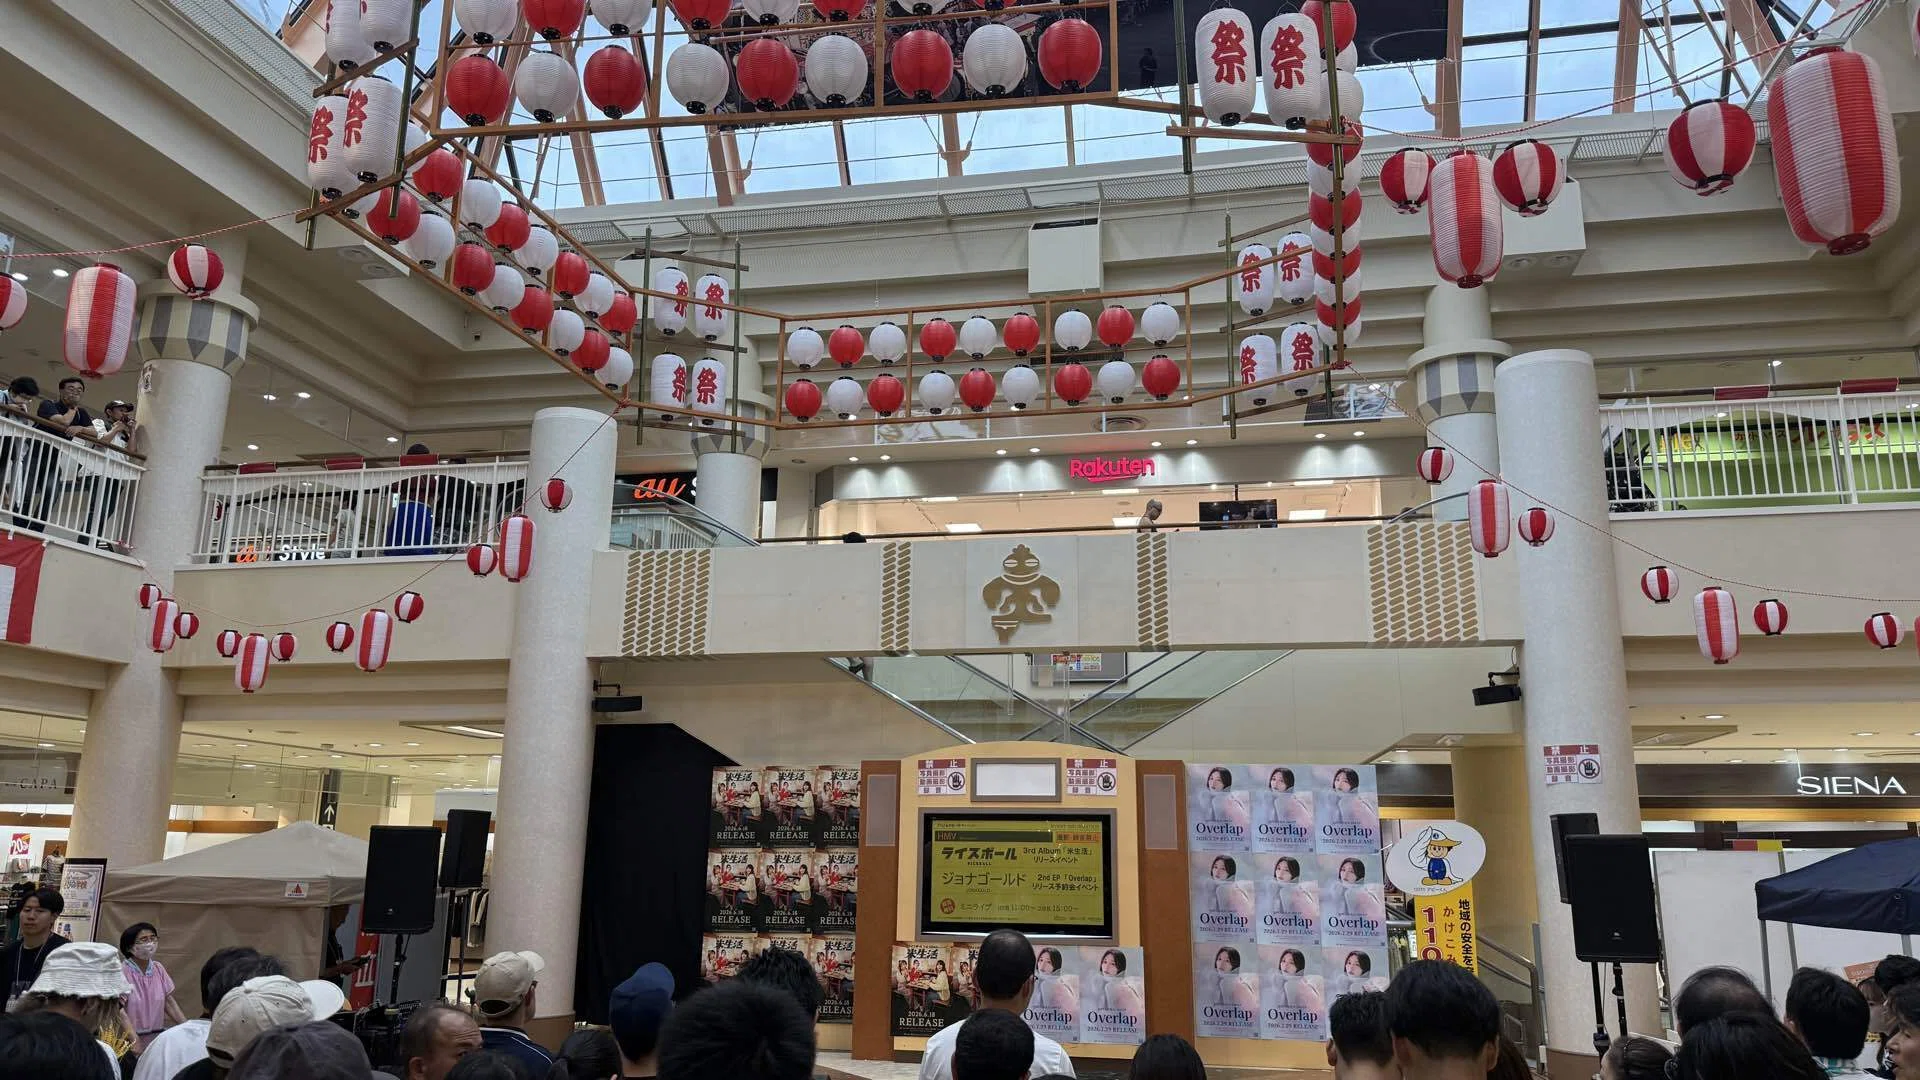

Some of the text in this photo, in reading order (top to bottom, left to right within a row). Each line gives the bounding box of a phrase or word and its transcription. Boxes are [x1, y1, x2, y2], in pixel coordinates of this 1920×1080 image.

[1211, 20, 1247, 85] 祭
[1270, 24, 1307, 89] 祭
[343, 88, 368, 148] 祭
[308, 105, 334, 164] 祭
[705, 282, 724, 320] 祭
[1292, 332, 1314, 370] 祭
[1241, 345, 1257, 384] 祭
[672, 363, 687, 403] 祭
[697, 367, 717, 404] 祭
[1070, 457, 1155, 478] Rakuten
[634, 478, 687, 499] au
[279, 543, 326, 561] Style
[1797, 776, 1907, 795] SIENA
[937, 832, 957, 840] HMV
[1196, 823, 1244, 836] Overlap
[1258, 824, 1307, 837] Overlap
[1322, 825, 1372, 838] Overlap
[942, 846, 1017, 860] ライスボール
[942, 871, 1027, 886] ジョナゴールド
[960, 903, 993, 911] ミニライブ
[711, 916, 751, 924] RELEASE
[765, 916, 805, 924] RELEASE
[820, 917, 857, 925] RELEAS
[1200, 913, 1248, 927] Overlap
[1264, 915, 1313, 929] Overlap
[1328, 917, 1378, 930] Overlap
[1421, 907, 1442, 960] 110
[1443, 907, 1456, 964] かけこみ
[1458, 899, 1474, 972] 地域の安全を
[816, 1006, 855, 1014] RELEAS
[1024, 1009, 1072, 1024] Overlap
[1203, 1006, 1252, 1021] Overlap
[1268, 1009, 1317, 1023] Overlap
[899, 1018, 944, 1027] RELEASE
[1088, 1011, 1137, 1027] Overlap
